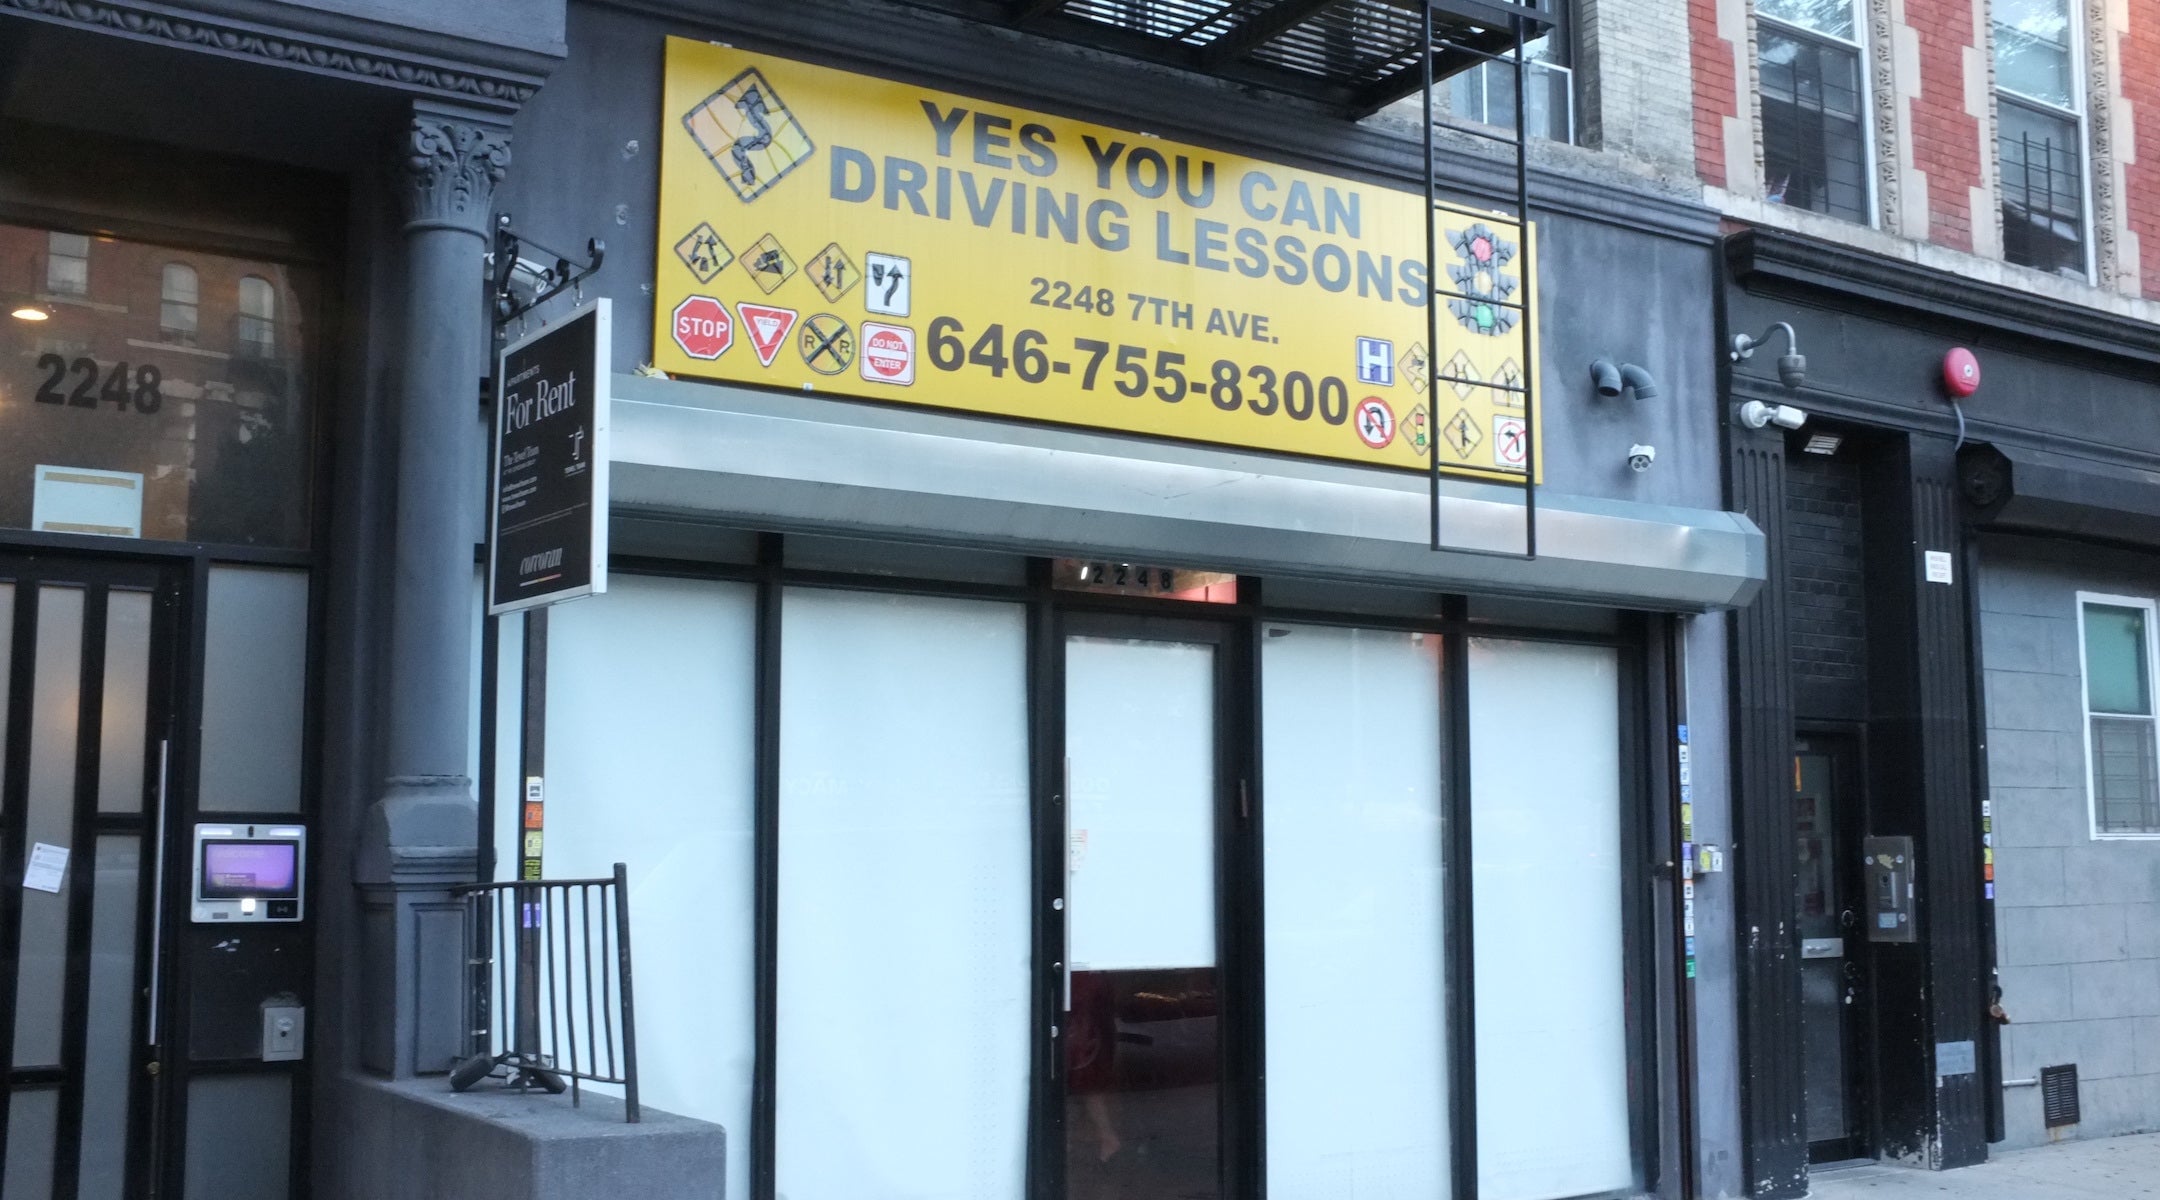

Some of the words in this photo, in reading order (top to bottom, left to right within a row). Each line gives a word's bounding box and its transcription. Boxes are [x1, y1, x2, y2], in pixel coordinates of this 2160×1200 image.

[920, 100, 1058, 177] YES
[1081, 135, 1215, 208] YOU
[1239, 171, 1361, 239] CAN
[830, 145, 1131, 252] DRIVING
[1156, 210, 1428, 307] LESSONS
[679, 316, 728, 339] STOP
[1030, 277, 1114, 316] 2248
[1127, 293, 1193, 330] 7TH
[1205, 310, 1279, 344] AVE.
[872, 337, 885, 348] DO
[886, 339, 904, 350] NOT
[873, 358, 902, 371] ENTER
[927, 316, 1349, 426] 646-755-8300
[1362, 341, 1388, 382] H
[35, 353, 162, 414] 2248
[505, 393, 533, 435] For
[536, 370, 576, 421] Rent
[1094, 566, 1172, 589] 2248
